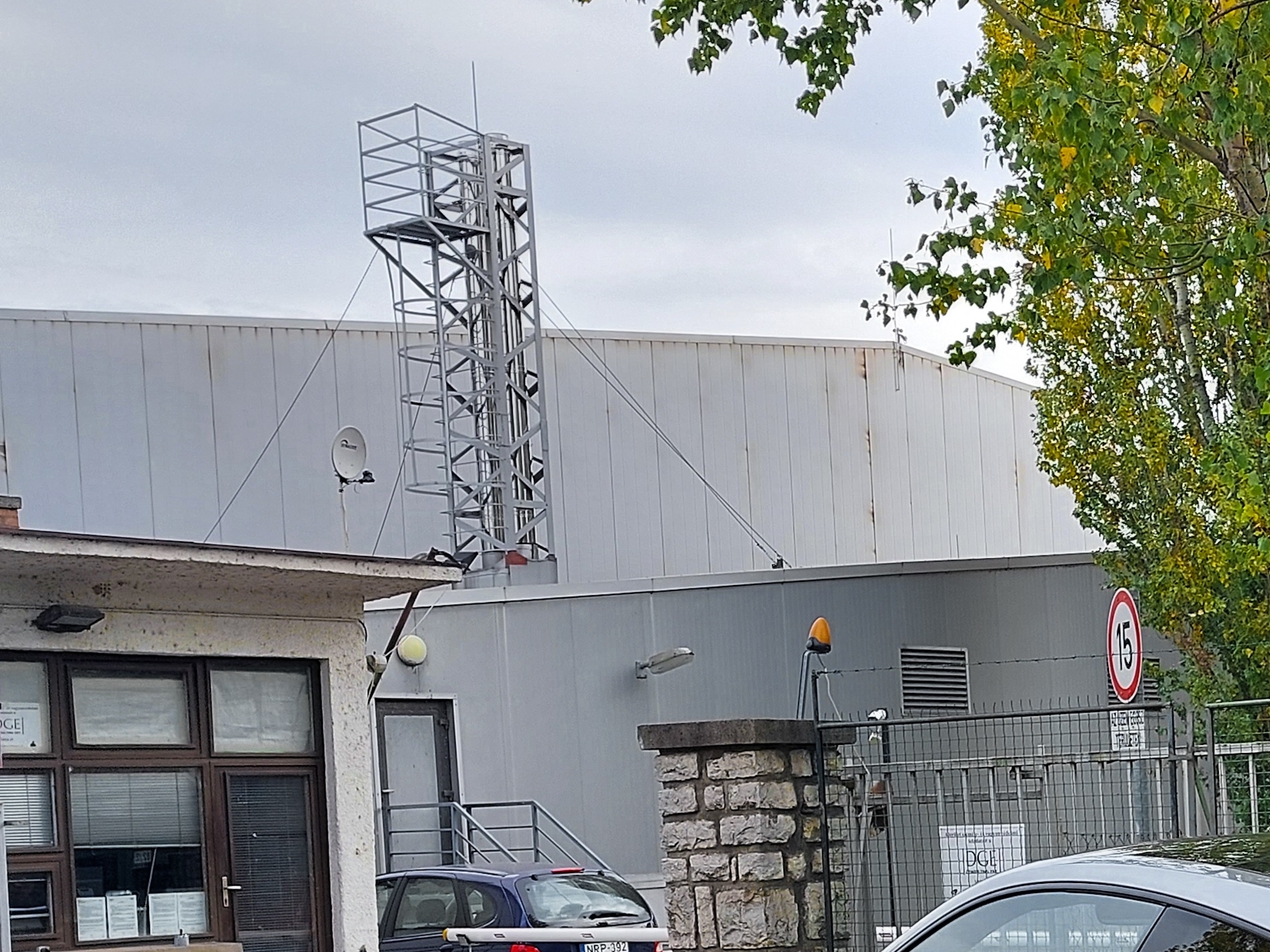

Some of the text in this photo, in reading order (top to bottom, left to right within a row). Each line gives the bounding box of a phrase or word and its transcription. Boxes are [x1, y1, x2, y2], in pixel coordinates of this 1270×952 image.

[1116, 621, 1133, 671] 15
[0, 718, 21, 730] GE
[966, 850, 997, 867] DGE
